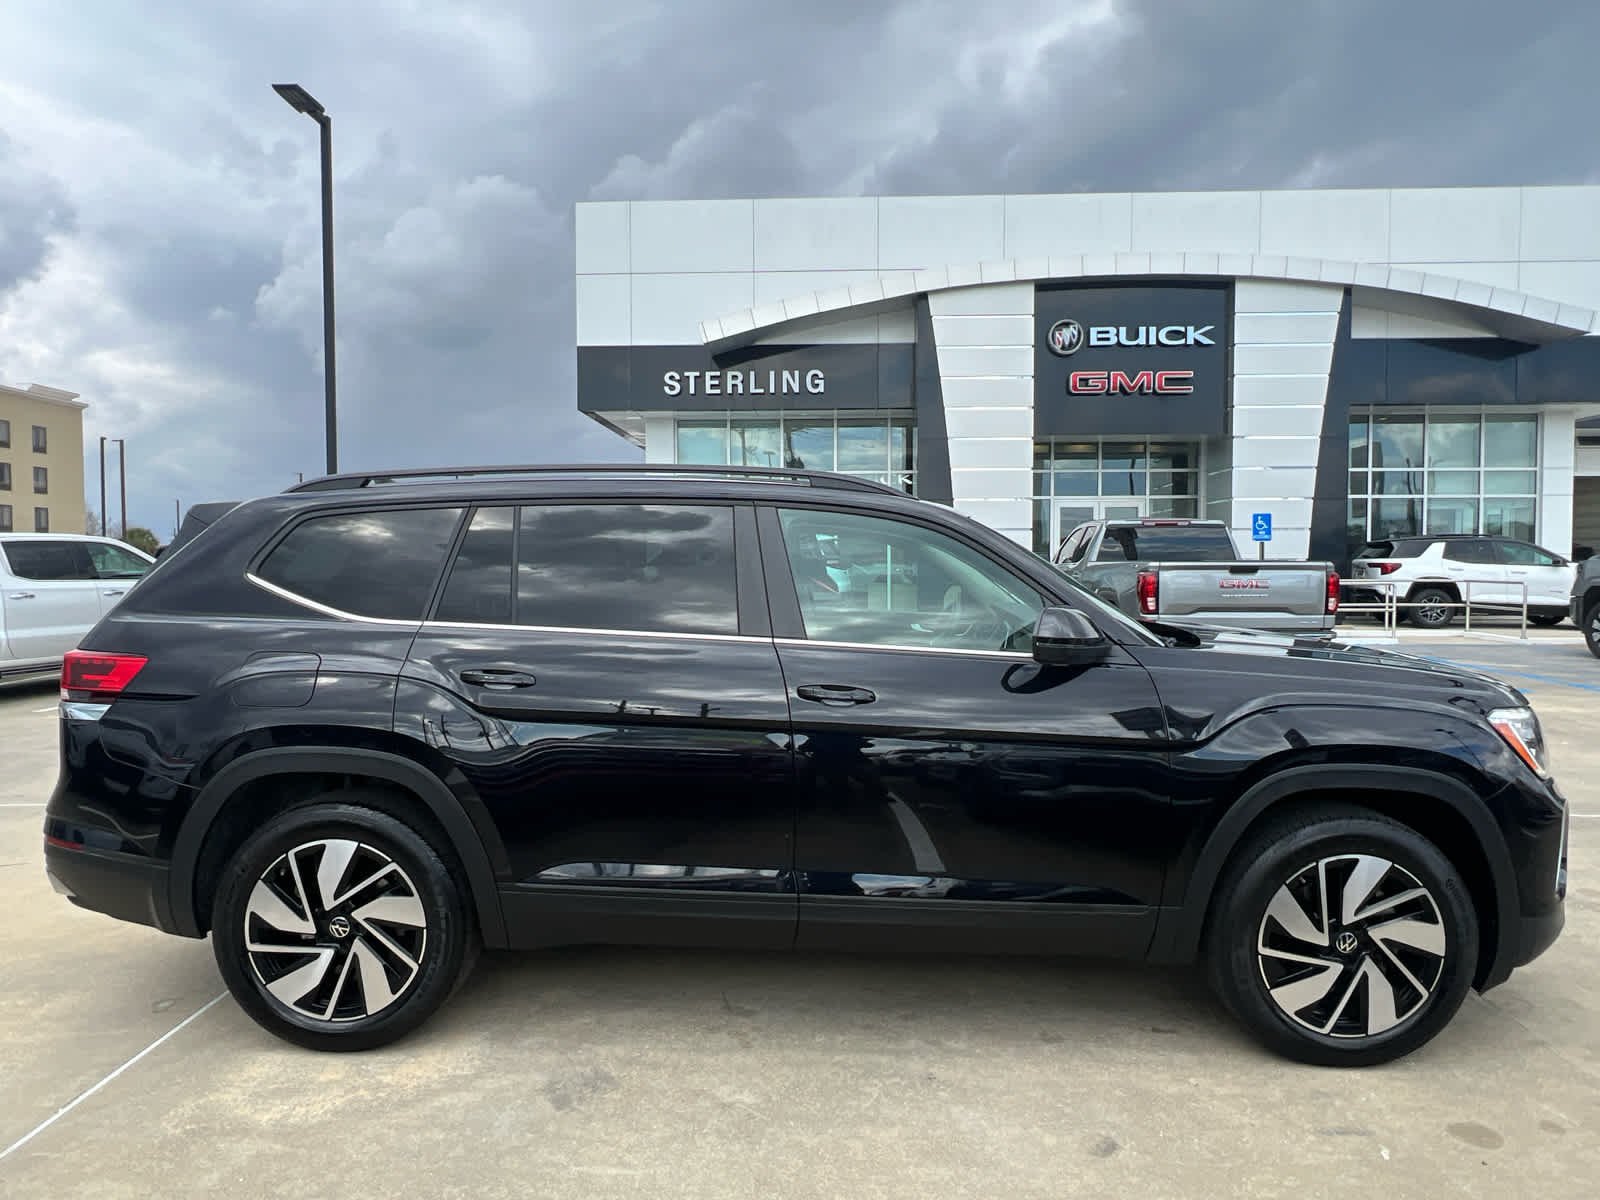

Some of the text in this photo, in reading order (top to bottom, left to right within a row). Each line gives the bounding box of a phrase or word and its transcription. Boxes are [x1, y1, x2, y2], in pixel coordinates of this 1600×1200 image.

[1089, 325, 1217, 346] BUICK
[663, 369, 825, 396] STERLING
[1070, 370, 1194, 394] GMC
[1218, 579, 1271, 590] GMC
